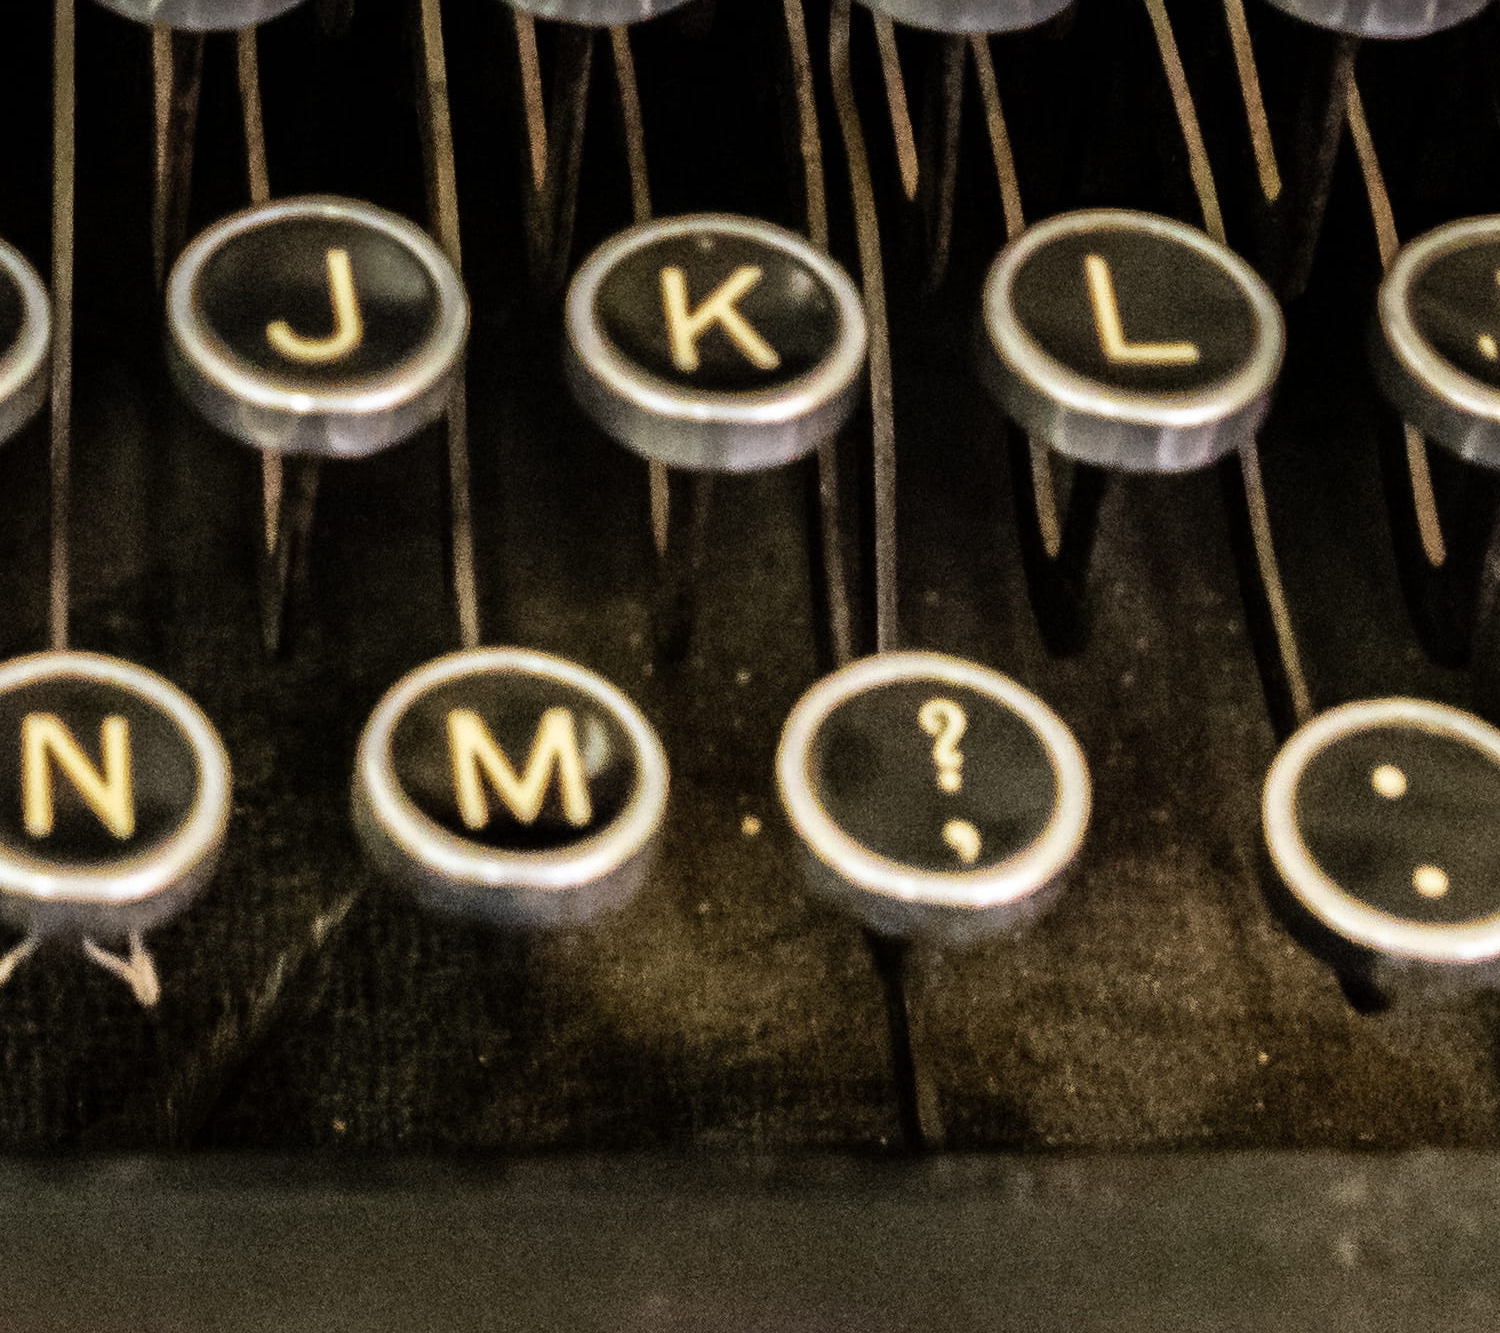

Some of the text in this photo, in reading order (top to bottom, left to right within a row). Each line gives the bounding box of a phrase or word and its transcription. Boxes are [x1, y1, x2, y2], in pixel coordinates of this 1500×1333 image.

[267, 248, 362, 362] J
[661, 266, 777, 369] K
[1085, 255, 1198, 364] L
[22, 713, 134, 836] N
[444, 706, 590, 824] M
[918, 697, 967, 793] ?
